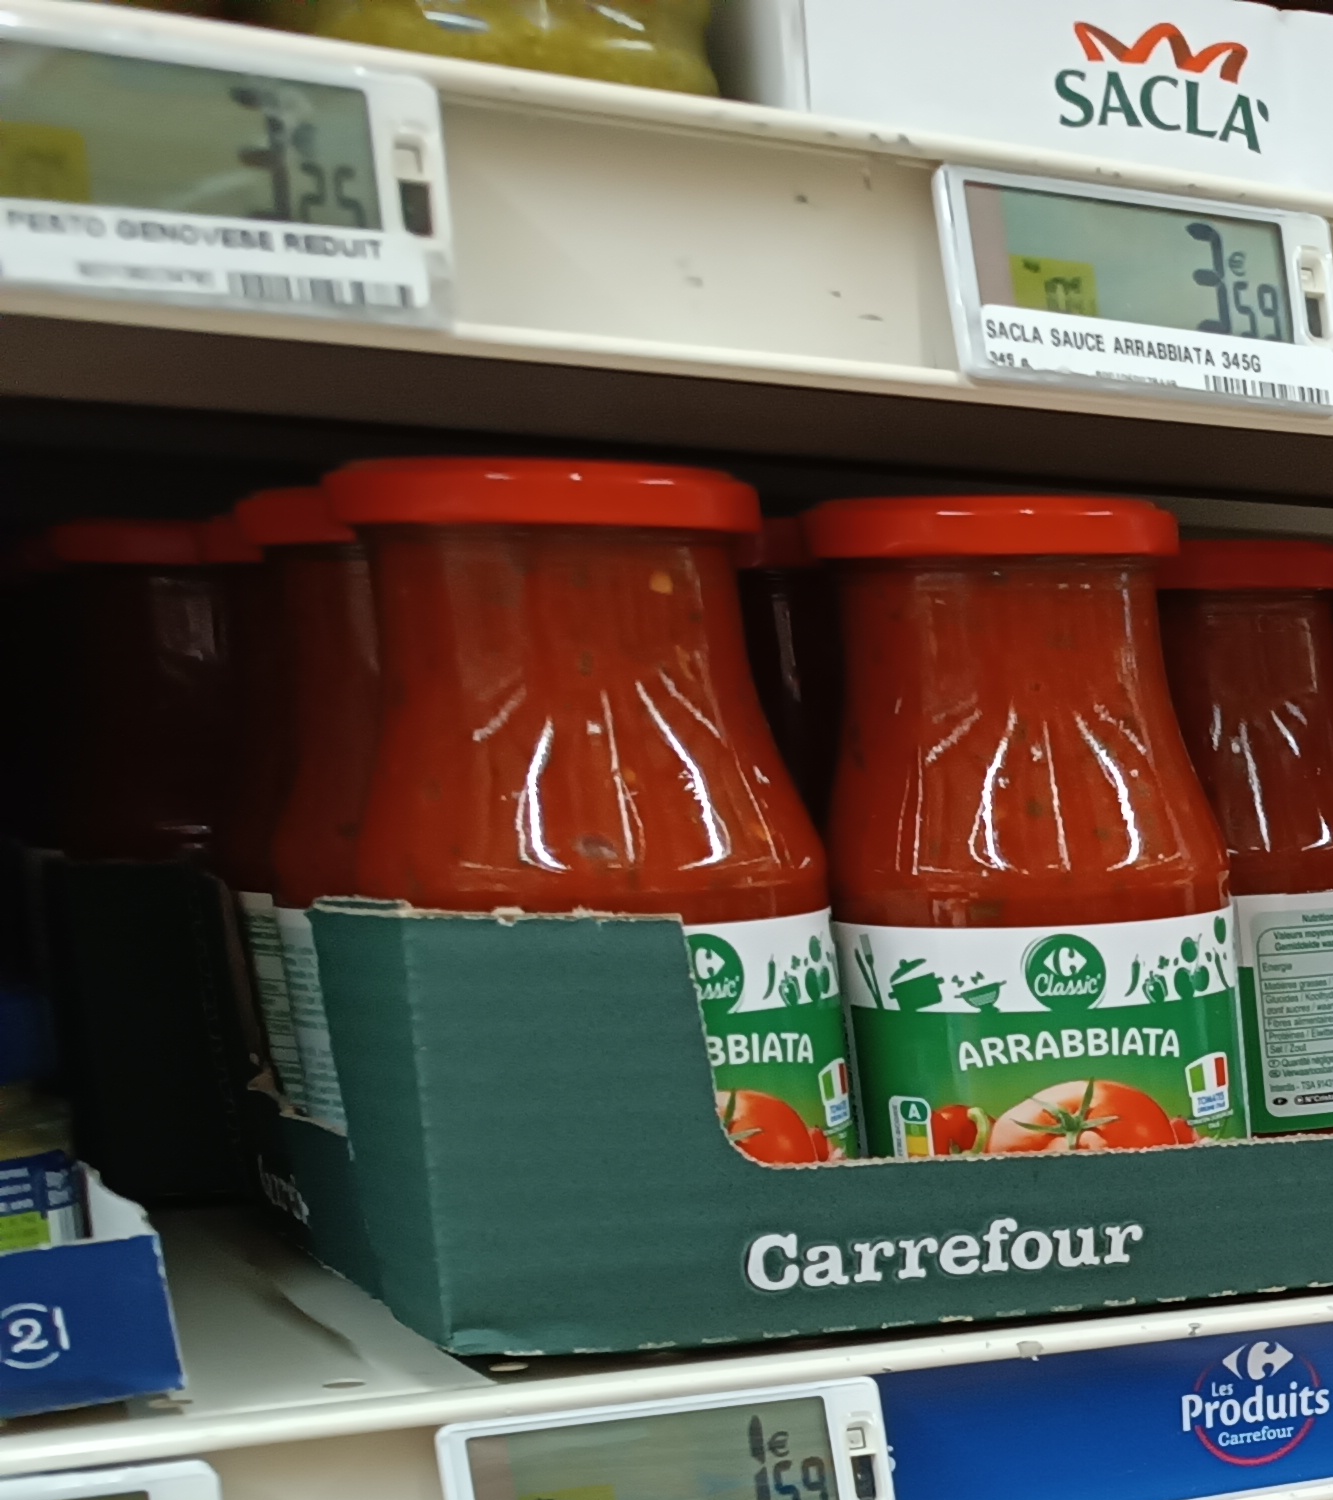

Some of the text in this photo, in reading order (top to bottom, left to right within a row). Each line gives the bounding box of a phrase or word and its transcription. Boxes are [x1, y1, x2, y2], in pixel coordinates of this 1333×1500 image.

[985, 318, 1262, 374] SACLA SAUCE ARRABBIATA 345G
[706, 1031, 814, 1067] BBIATA
[957, 1025, 1180, 1072] ARRABBIATA
[744, 1217, 1144, 1291] Carrefour
[1181, 1384, 1331, 1432] Produits
[1210, 1381, 1234, 1400] Les
[1217, 1422, 1295, 1448] Carrefour
